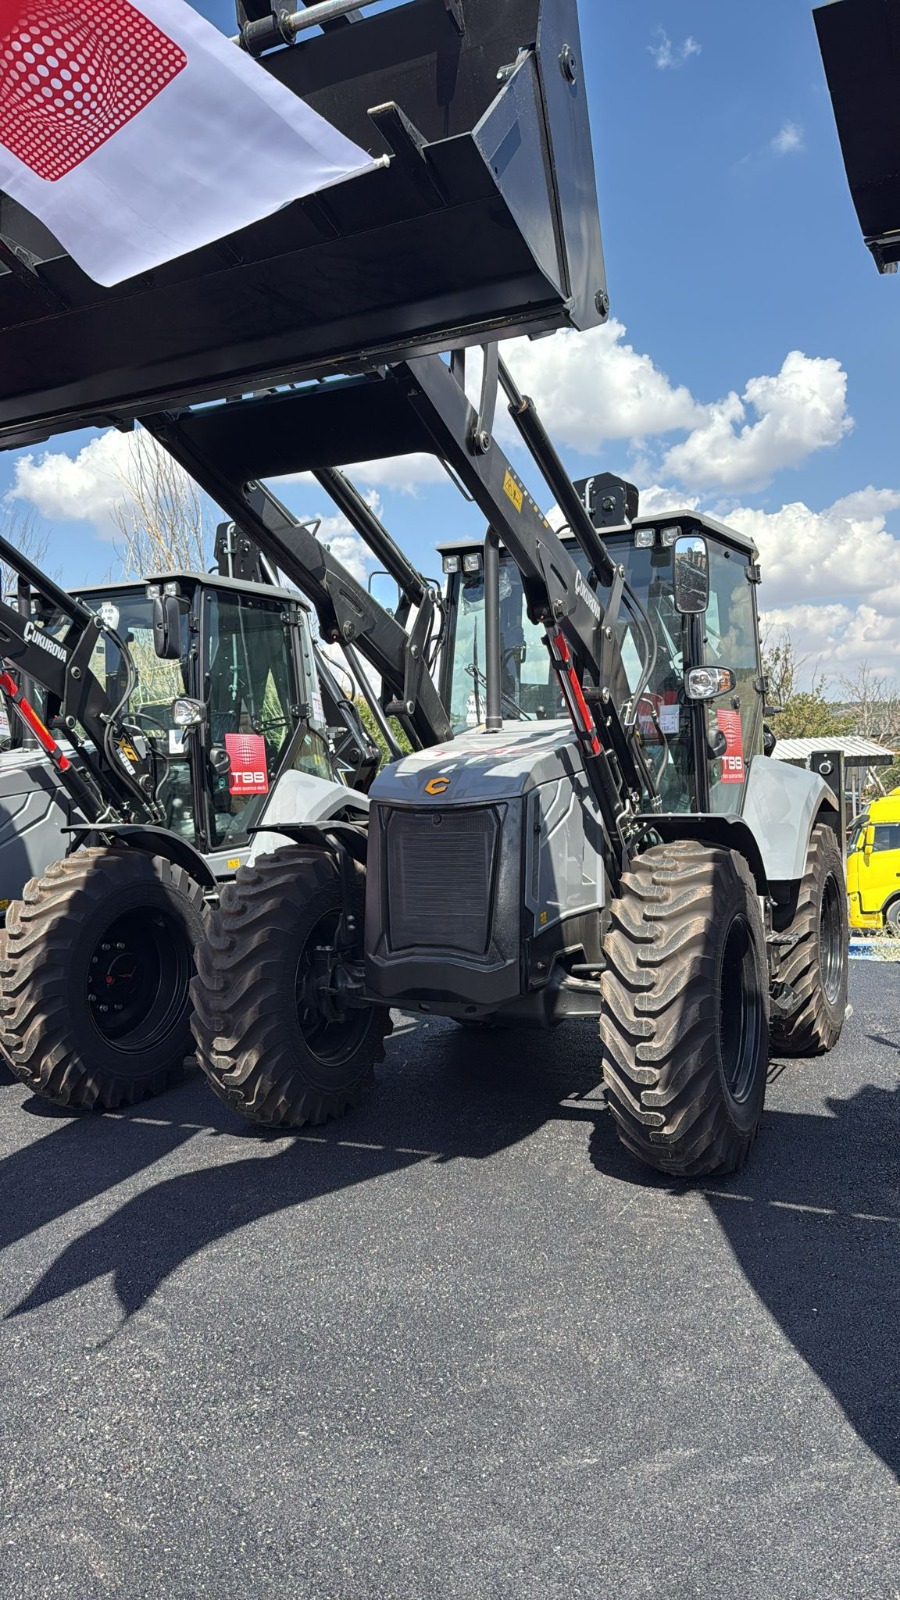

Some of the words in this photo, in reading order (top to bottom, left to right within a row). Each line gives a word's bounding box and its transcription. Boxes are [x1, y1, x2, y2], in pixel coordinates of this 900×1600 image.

[23, 621, 67, 663] ÇUKUROVA
[721, 756, 743, 770] TBB
[231, 771, 265, 784] TBB
